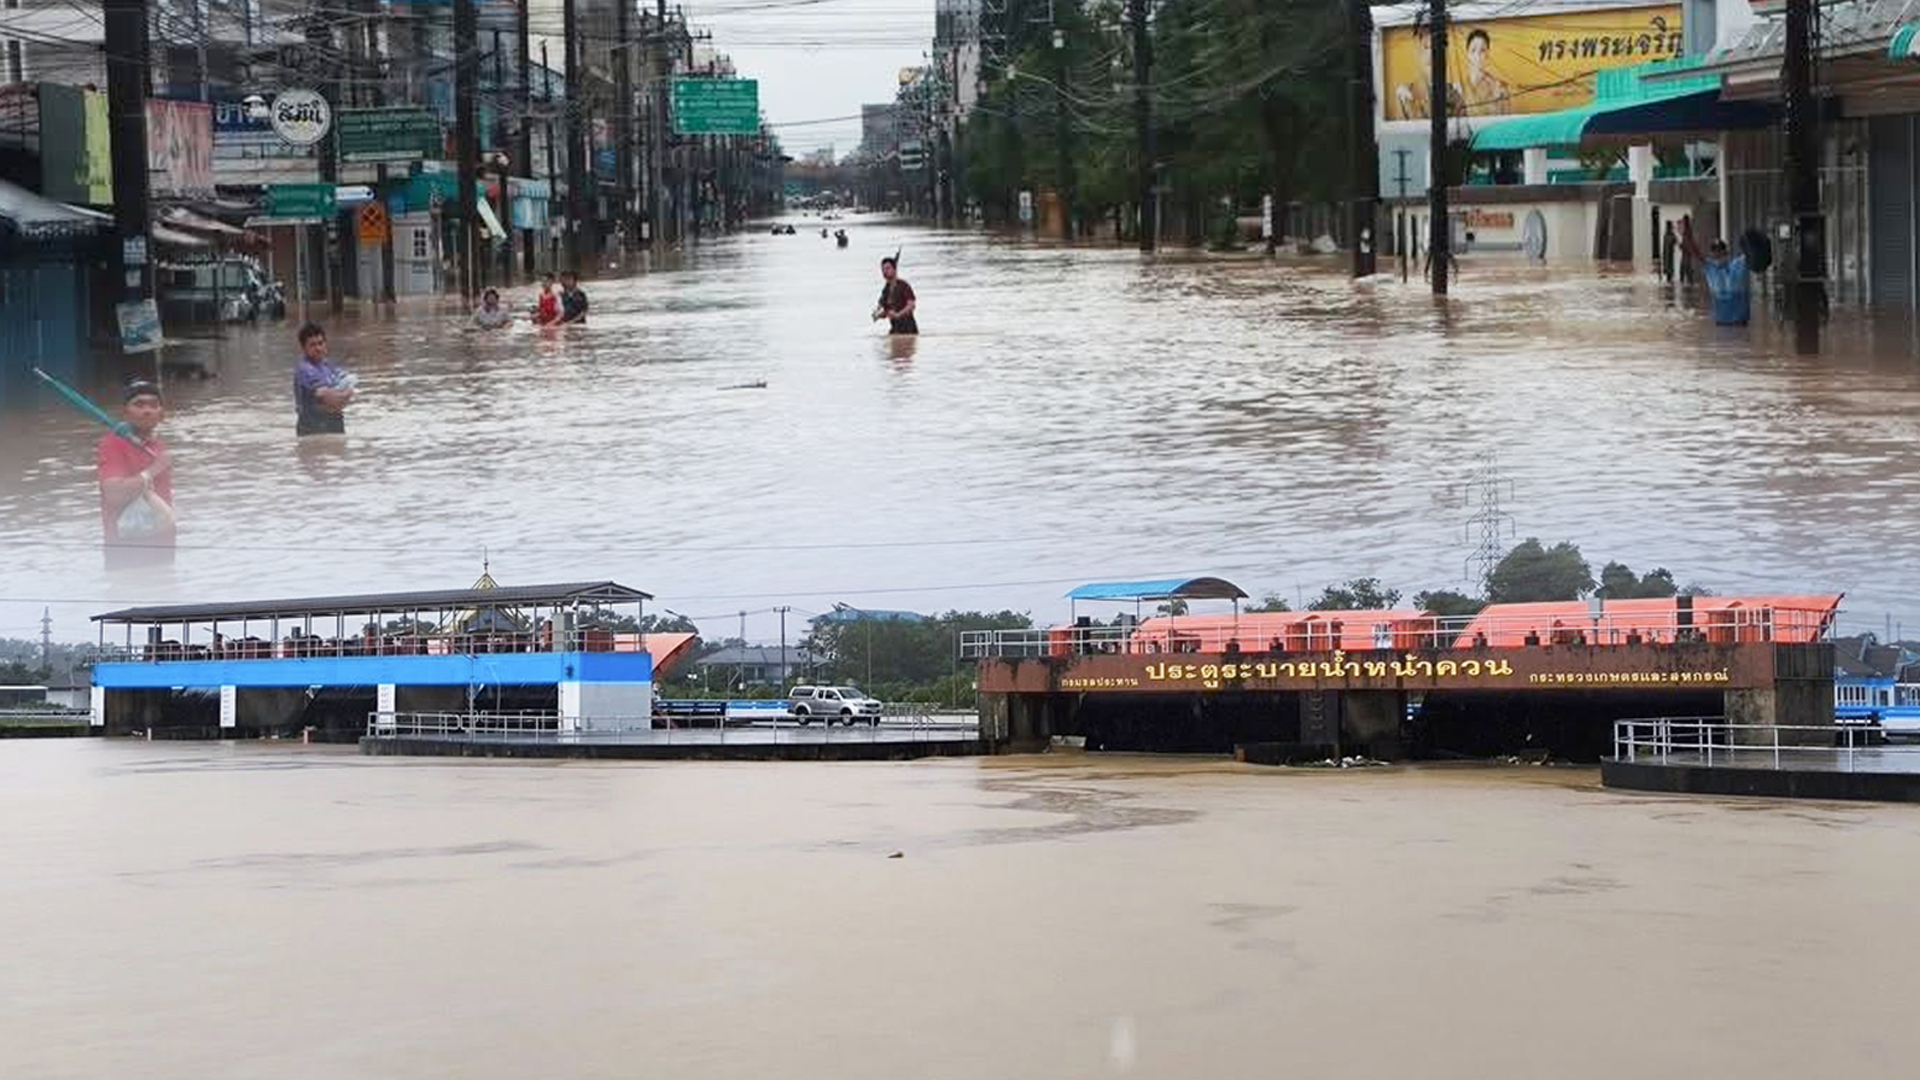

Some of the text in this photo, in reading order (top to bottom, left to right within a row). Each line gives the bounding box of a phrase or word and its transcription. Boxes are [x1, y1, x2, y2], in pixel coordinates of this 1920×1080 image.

[1145, 650, 1514, 688] ประตูระบายน้ำหน้าควน
[1529, 668, 1729, 683] กระทรวงเกษตรและสหกรณ์
[1061, 676, 1140, 687] กรมชลประทาน
